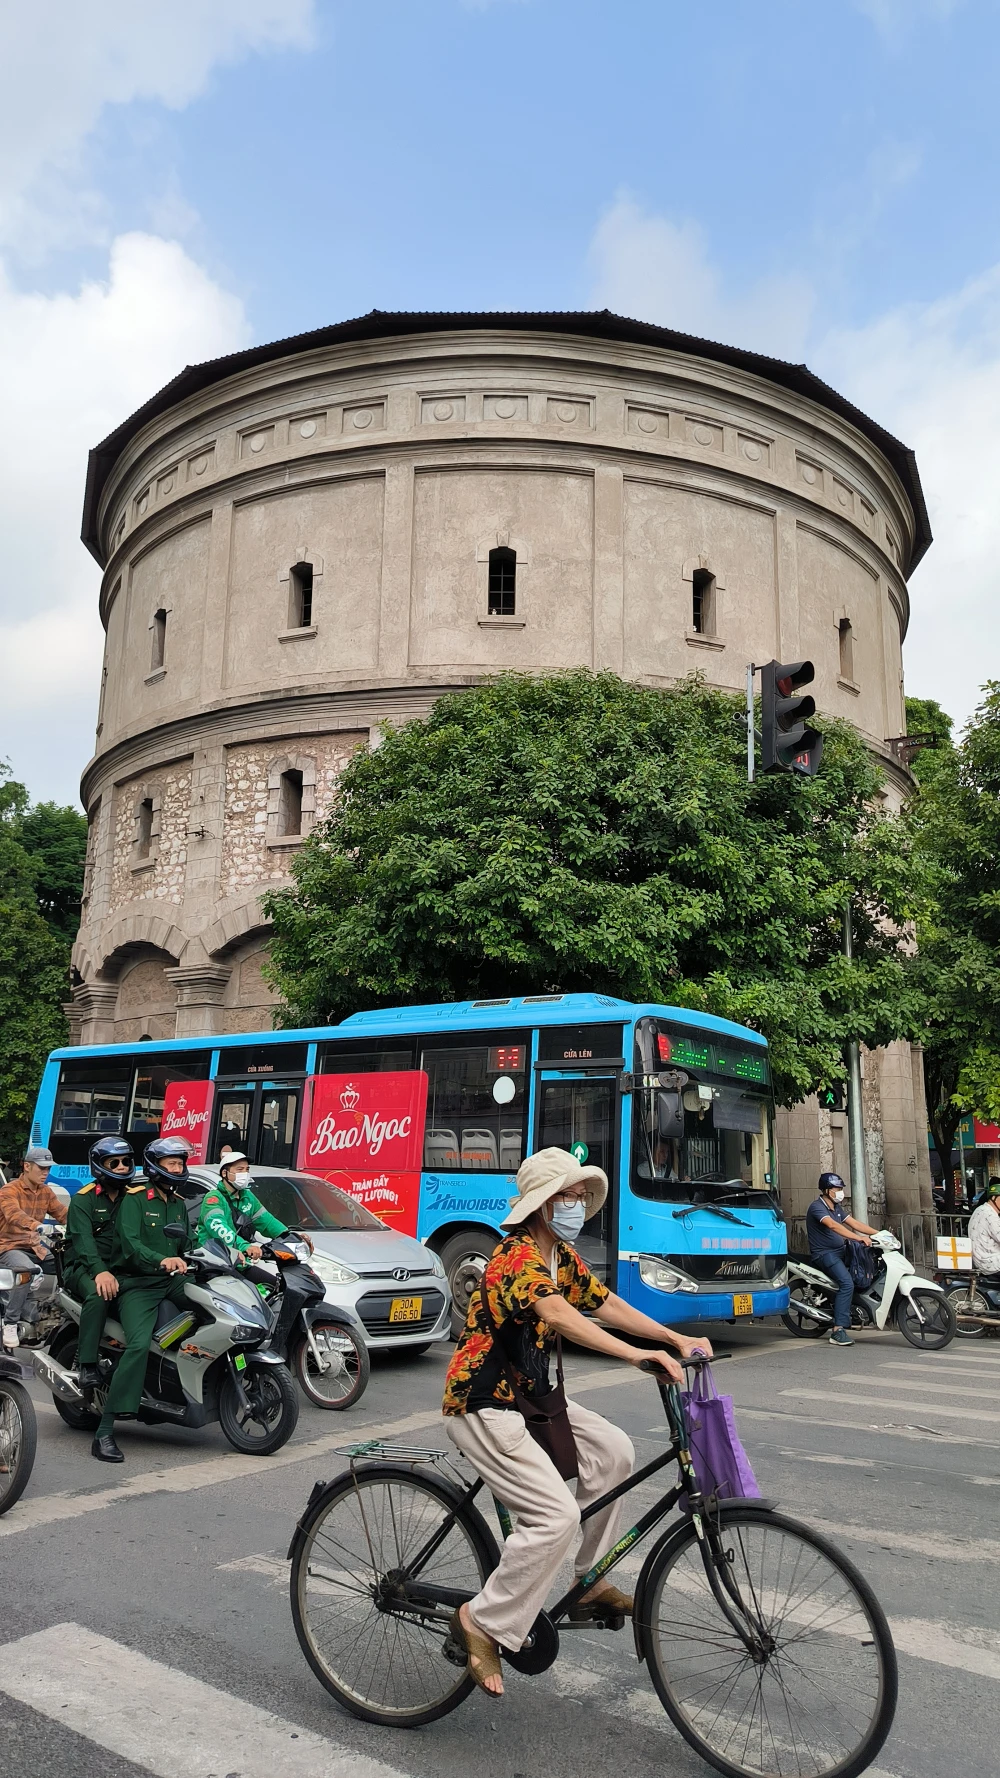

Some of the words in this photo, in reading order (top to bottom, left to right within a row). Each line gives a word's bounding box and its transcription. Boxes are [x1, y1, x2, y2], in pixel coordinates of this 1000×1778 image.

[58, 1165, 71, 1178] 29B
[425, 1193, 508, 1211] HANOIBUS
[400, 1299, 414, 1309] 30A
[393, 1309, 419, 1321] 606.50
